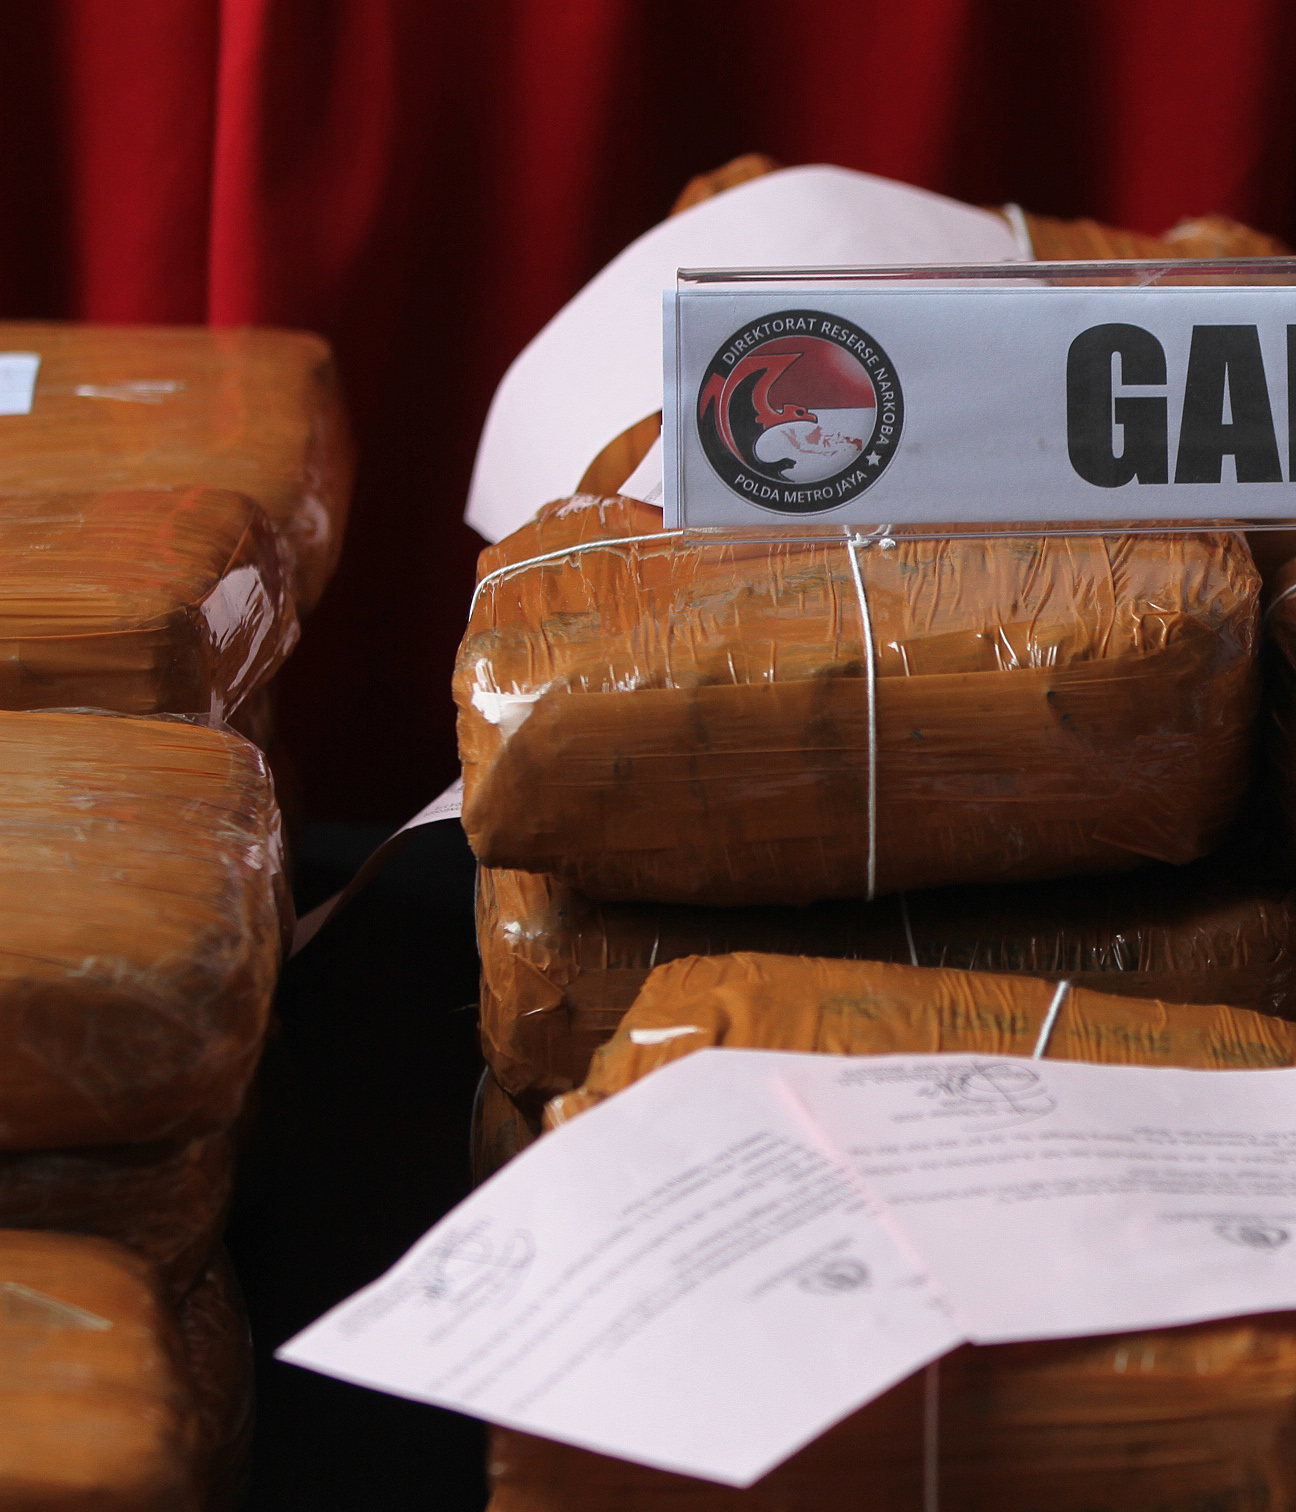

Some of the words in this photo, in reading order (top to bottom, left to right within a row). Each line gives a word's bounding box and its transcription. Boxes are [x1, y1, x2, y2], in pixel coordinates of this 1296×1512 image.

[722, 317, 817, 366] DIREKTORAT
[820, 321, 880, 367] RESERSE
[873, 367, 897, 446] NARKOBA
[734, 474, 780, 502] POLDA
[784, 487, 833, 503] METRO
[837, 470, 868, 498] JAYA
